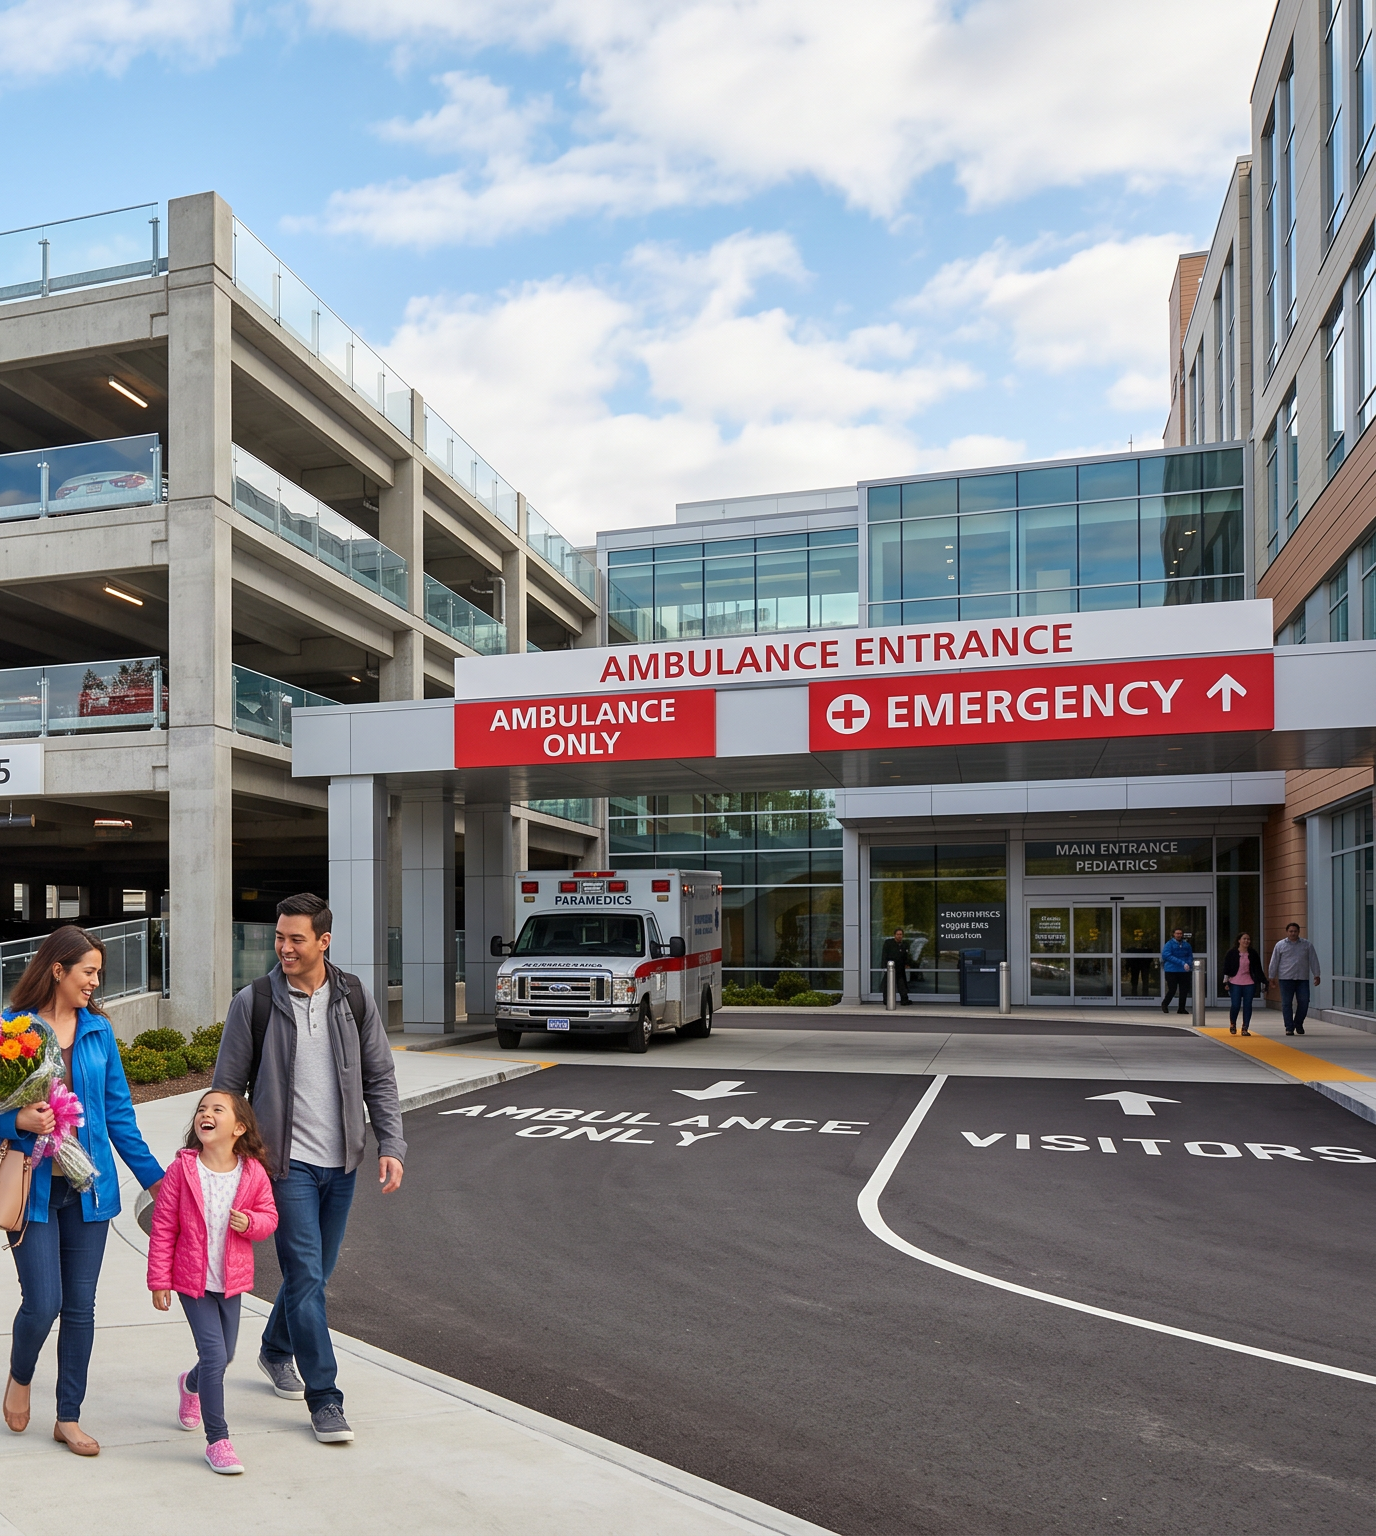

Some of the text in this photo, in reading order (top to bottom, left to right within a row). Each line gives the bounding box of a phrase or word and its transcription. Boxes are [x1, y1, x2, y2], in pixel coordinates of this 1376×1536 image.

[599, 623, 1075, 684] AMBULANCE ENTRANCE
[490, 698, 676, 732] AMBULANCE
[887, 678, 1185, 729] EMERGENCY
[543, 731, 622, 757] ONLY
[1056, 842, 1179, 856] MAIN ENTRANCE
[1076, 859, 1158, 872] PEDIATRICS
[554, 895, 633, 906] PARAMEDICS
[438, 1104, 870, 1135] AMBULANCE
[515, 1124, 722, 1147] ONLY
[960, 1130, 1376, 1164] VISITORS
